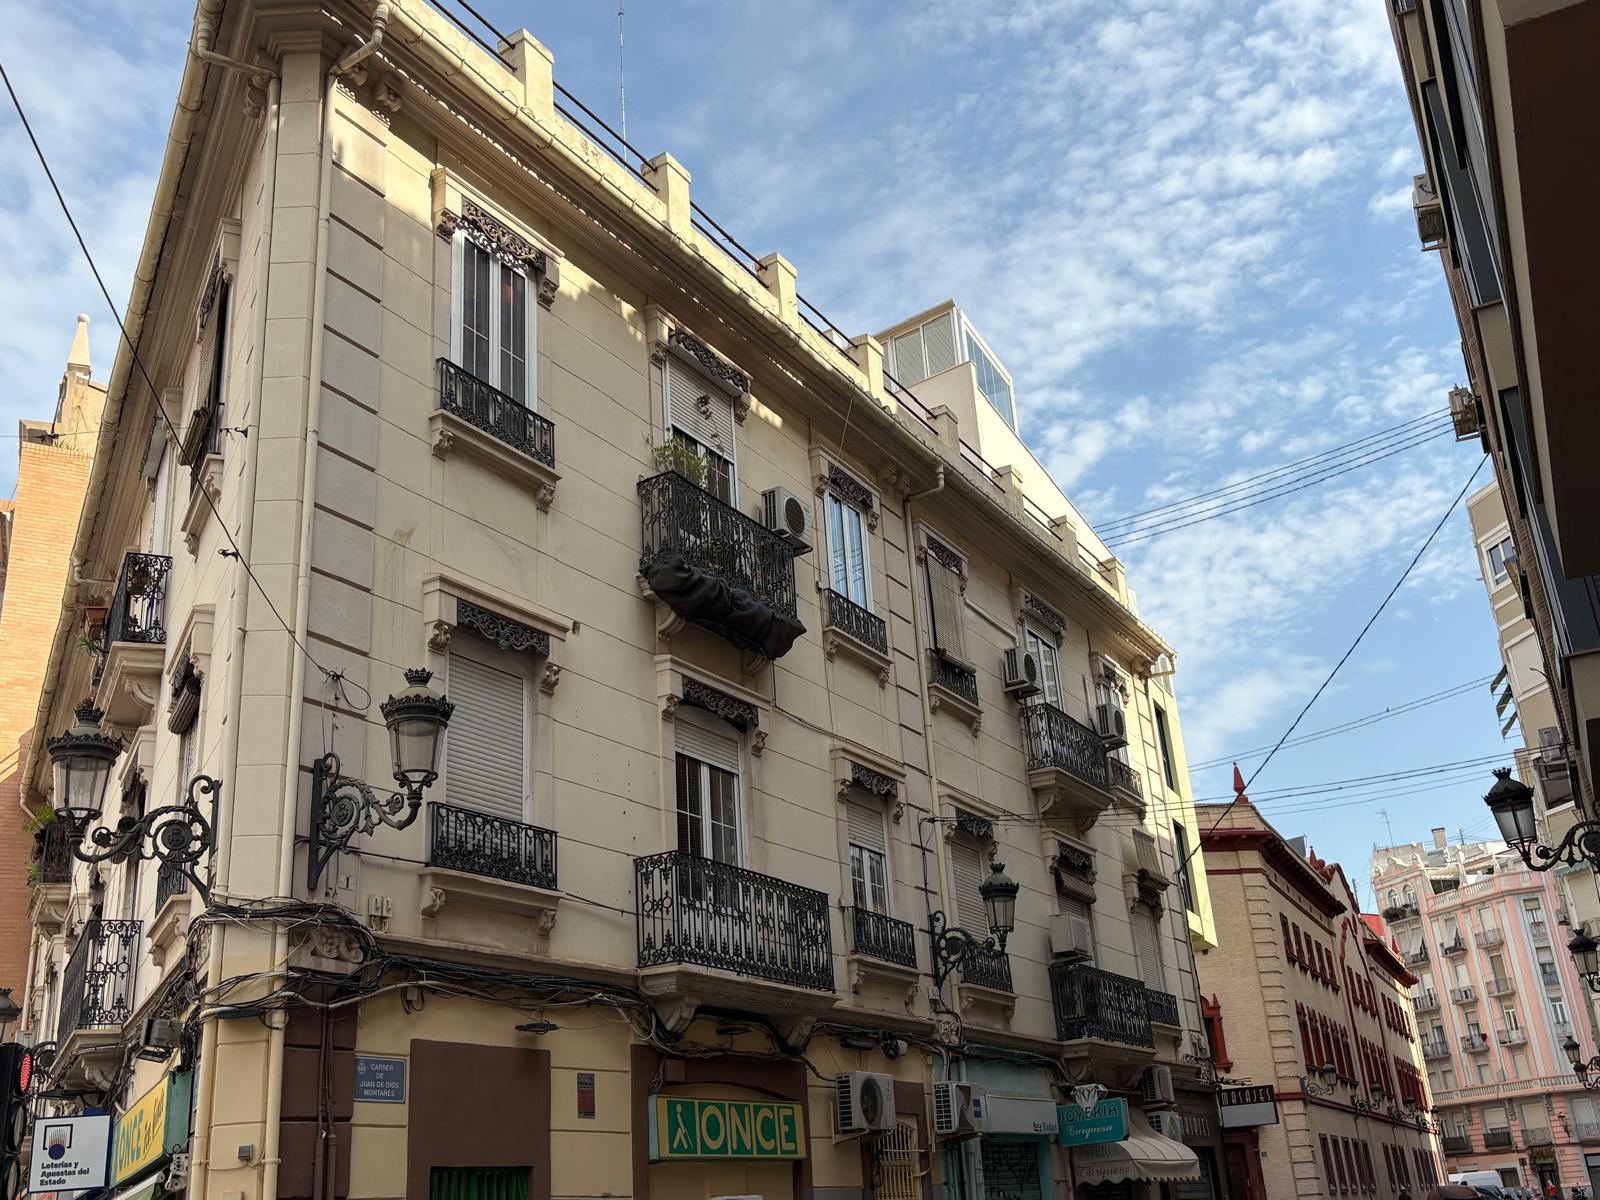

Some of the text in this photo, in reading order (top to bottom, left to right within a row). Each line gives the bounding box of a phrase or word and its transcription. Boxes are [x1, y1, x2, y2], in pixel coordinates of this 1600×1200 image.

[370, 1063, 394, 1071] CARRER
[364, 1088, 395, 1097] MONTAÑÉS
[1221, 1087, 1271, 1106] MASAJES
[701, 1105, 796, 1150] ONCE
[1066, 1124, 1113, 1142] Turquesa
[119, 1108, 144, 1171] ONCE
[41, 1161, 72, 1169] Loterías
[40, 1169, 76, 1178] Apuestas
[39, 1178, 66, 1186] Estado
